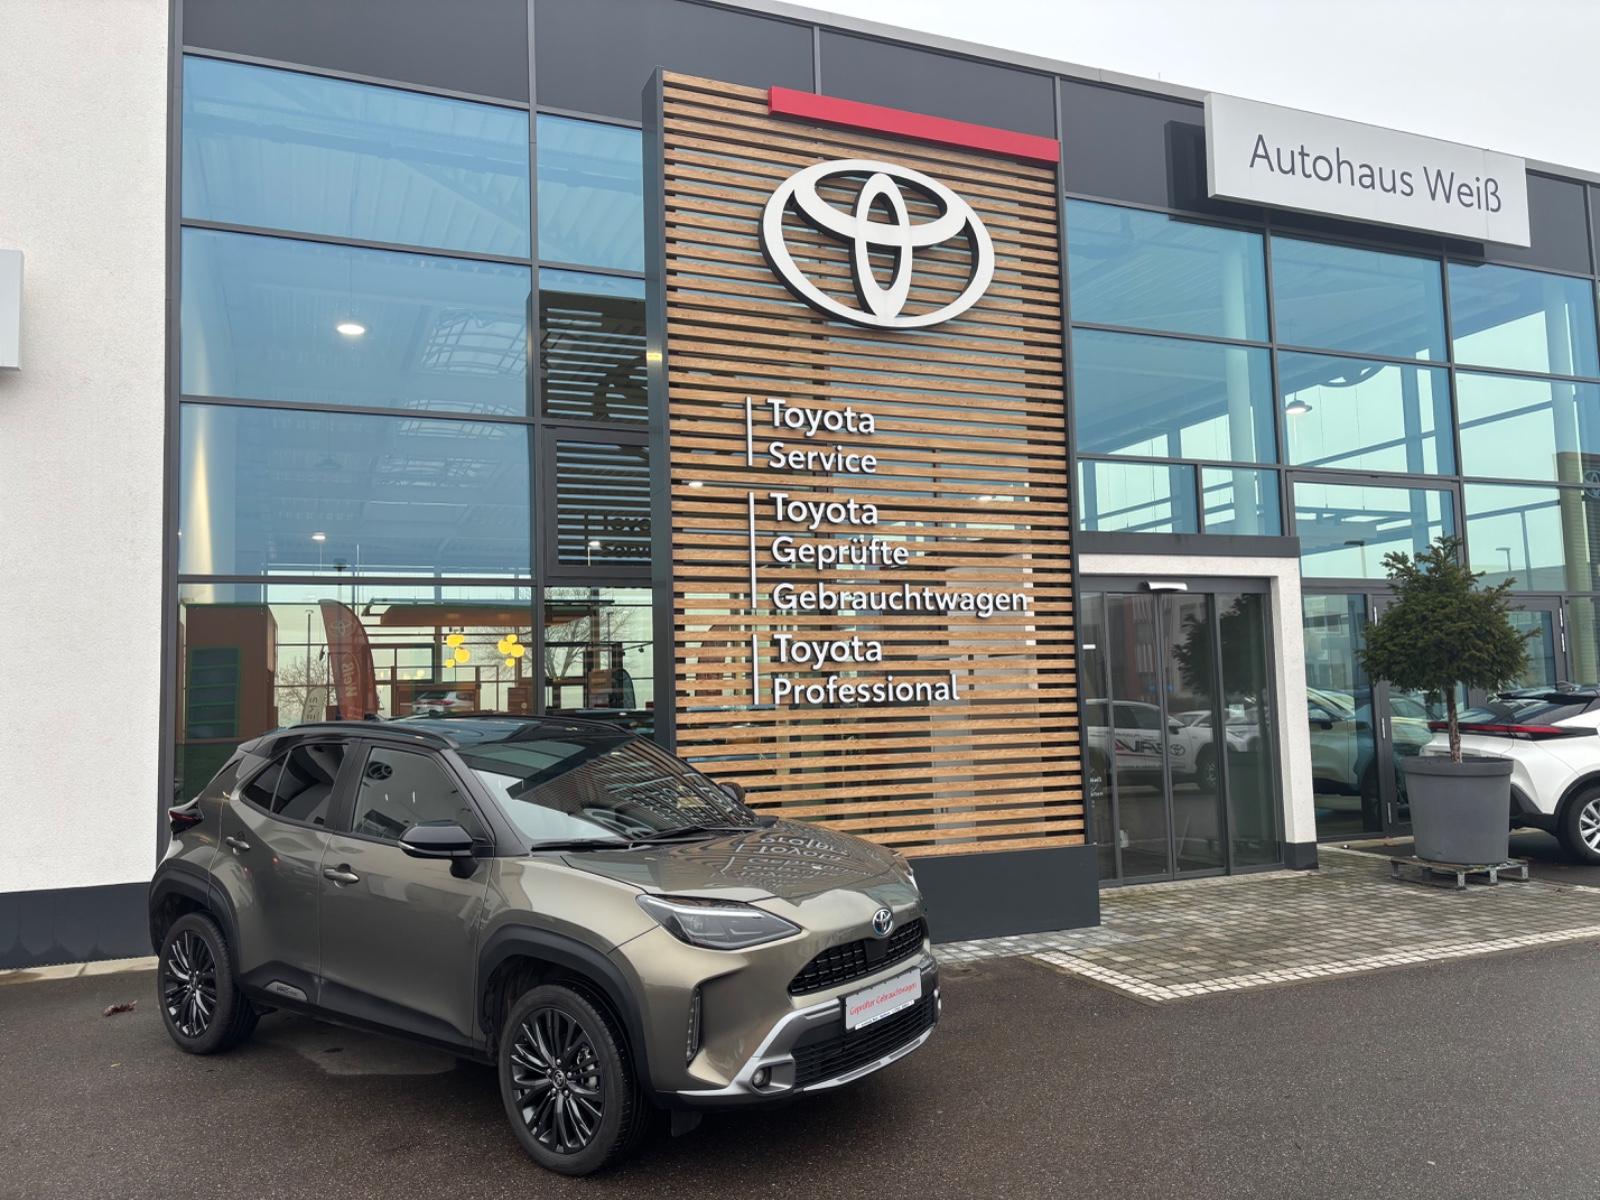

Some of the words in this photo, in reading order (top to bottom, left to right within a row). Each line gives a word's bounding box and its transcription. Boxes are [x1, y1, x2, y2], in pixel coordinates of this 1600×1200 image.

[1249, 134, 1414, 197] Autohaus
[1423, 166, 1502, 213] Weiß
[767, 398, 876, 436] Toyota
[768, 442, 878, 474] Service
[769, 493, 879, 529] Toyota
[771, 536, 909, 570] Geprüfte
[772, 583, 1029, 616] Gebrauchtwagen
[773, 634, 883, 669] Toyota
[774, 674, 961, 705] Professional
